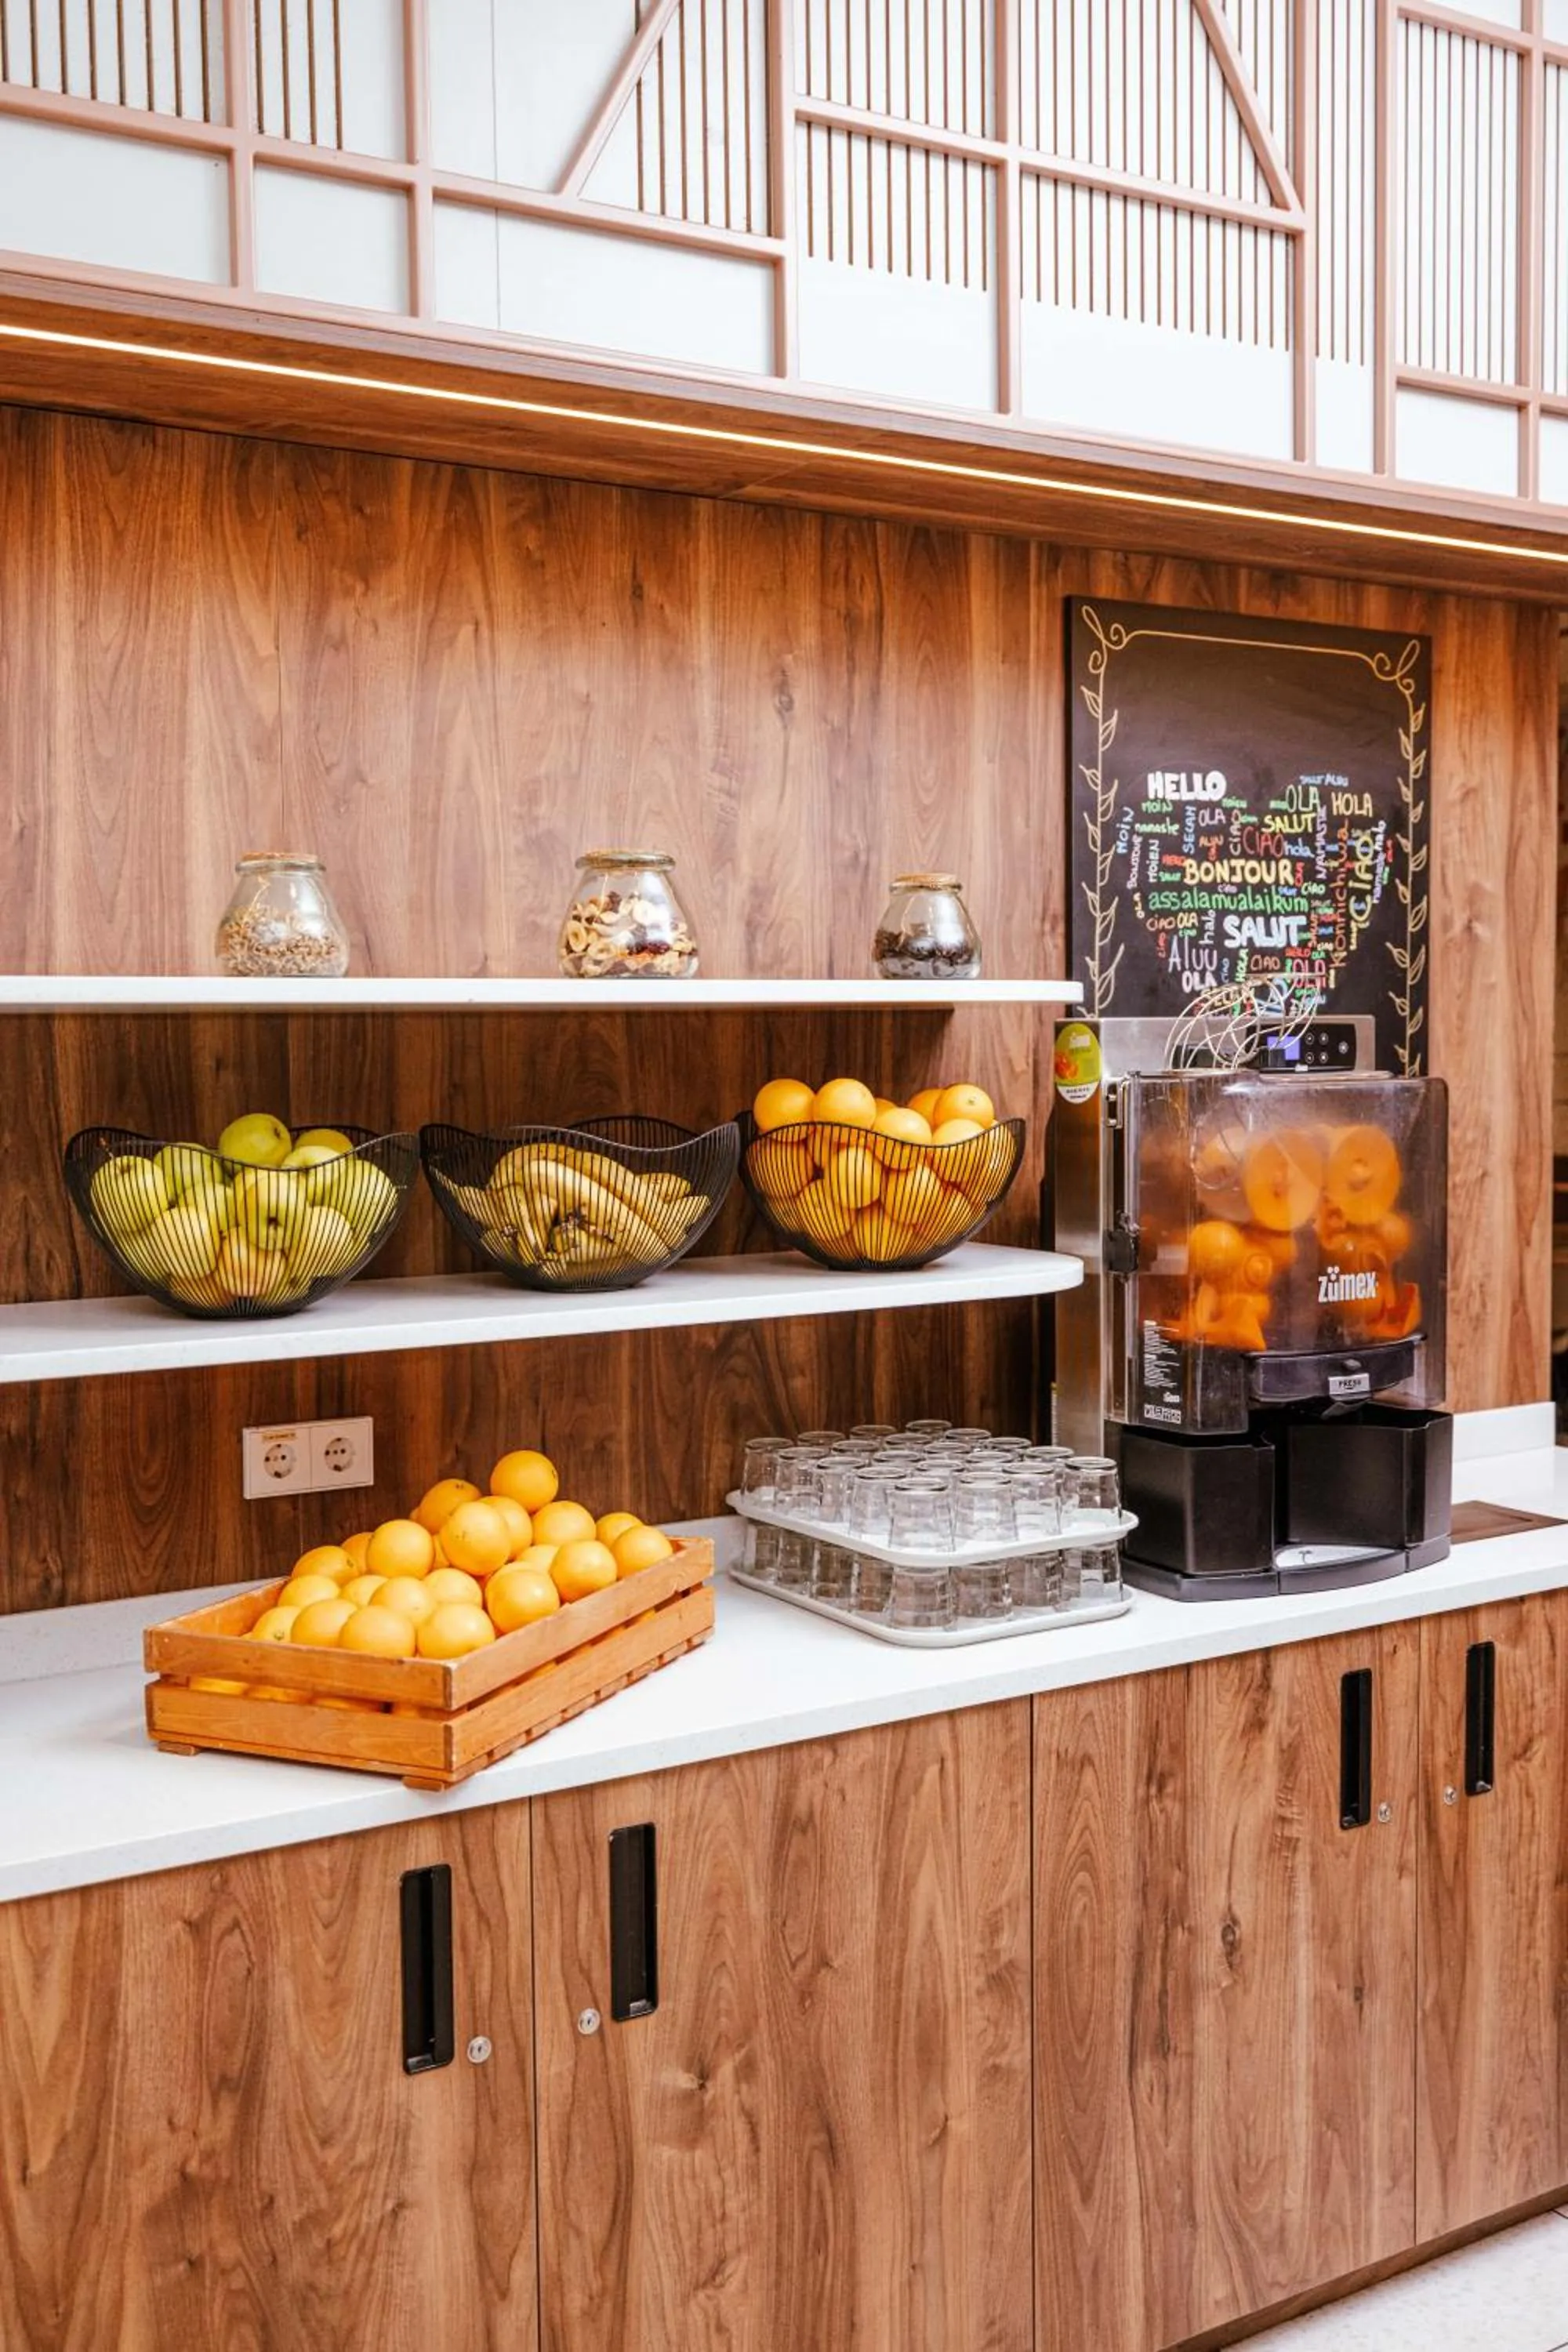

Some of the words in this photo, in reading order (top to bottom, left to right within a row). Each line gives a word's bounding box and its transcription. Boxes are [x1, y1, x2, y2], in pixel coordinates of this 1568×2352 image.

[1147, 771, 1227, 801] HELLO
[1286, 784, 1322, 813] OLA
[1199, 808, 1226, 827] OLA
[1330, 790, 1373, 818] HOLA
[1261, 812, 1316, 834] SALUT
[1243, 825, 1284, 858] CIAO
[1183, 858, 1294, 885] BONJOUR
[1177, 912, 1199, 930] OLA
[1199, 909, 1217, 946] halo
[1223, 914, 1307, 949] SALUT
[1250, 954, 1281, 972] CIAO
[1181, 970, 1218, 995] OLA
[1318, 1266, 1377, 1303] zümex
